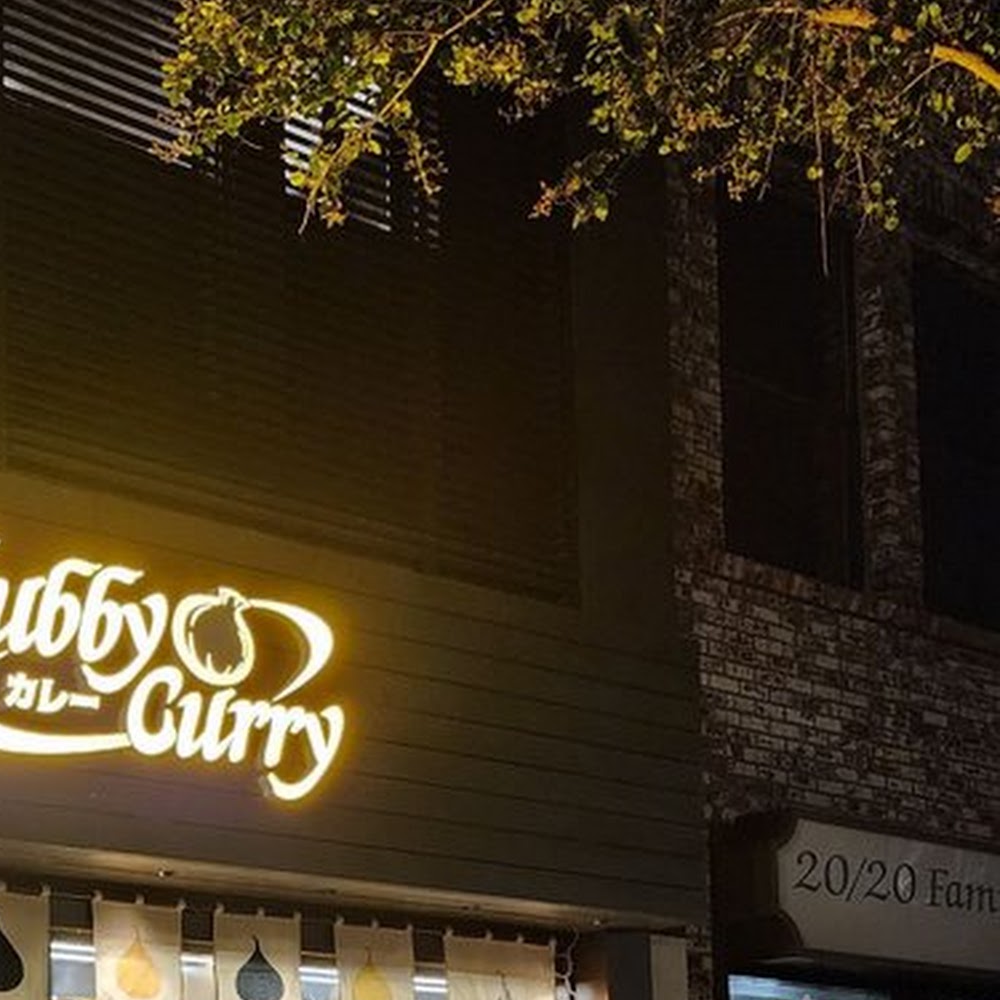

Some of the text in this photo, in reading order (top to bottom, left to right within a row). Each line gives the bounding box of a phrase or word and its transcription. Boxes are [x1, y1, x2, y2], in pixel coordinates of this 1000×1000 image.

[3, 672, 101, 714] カレー
[126, 665, 345, 800] Curry
[793, 851, 1000, 912] 20/20 Fam
